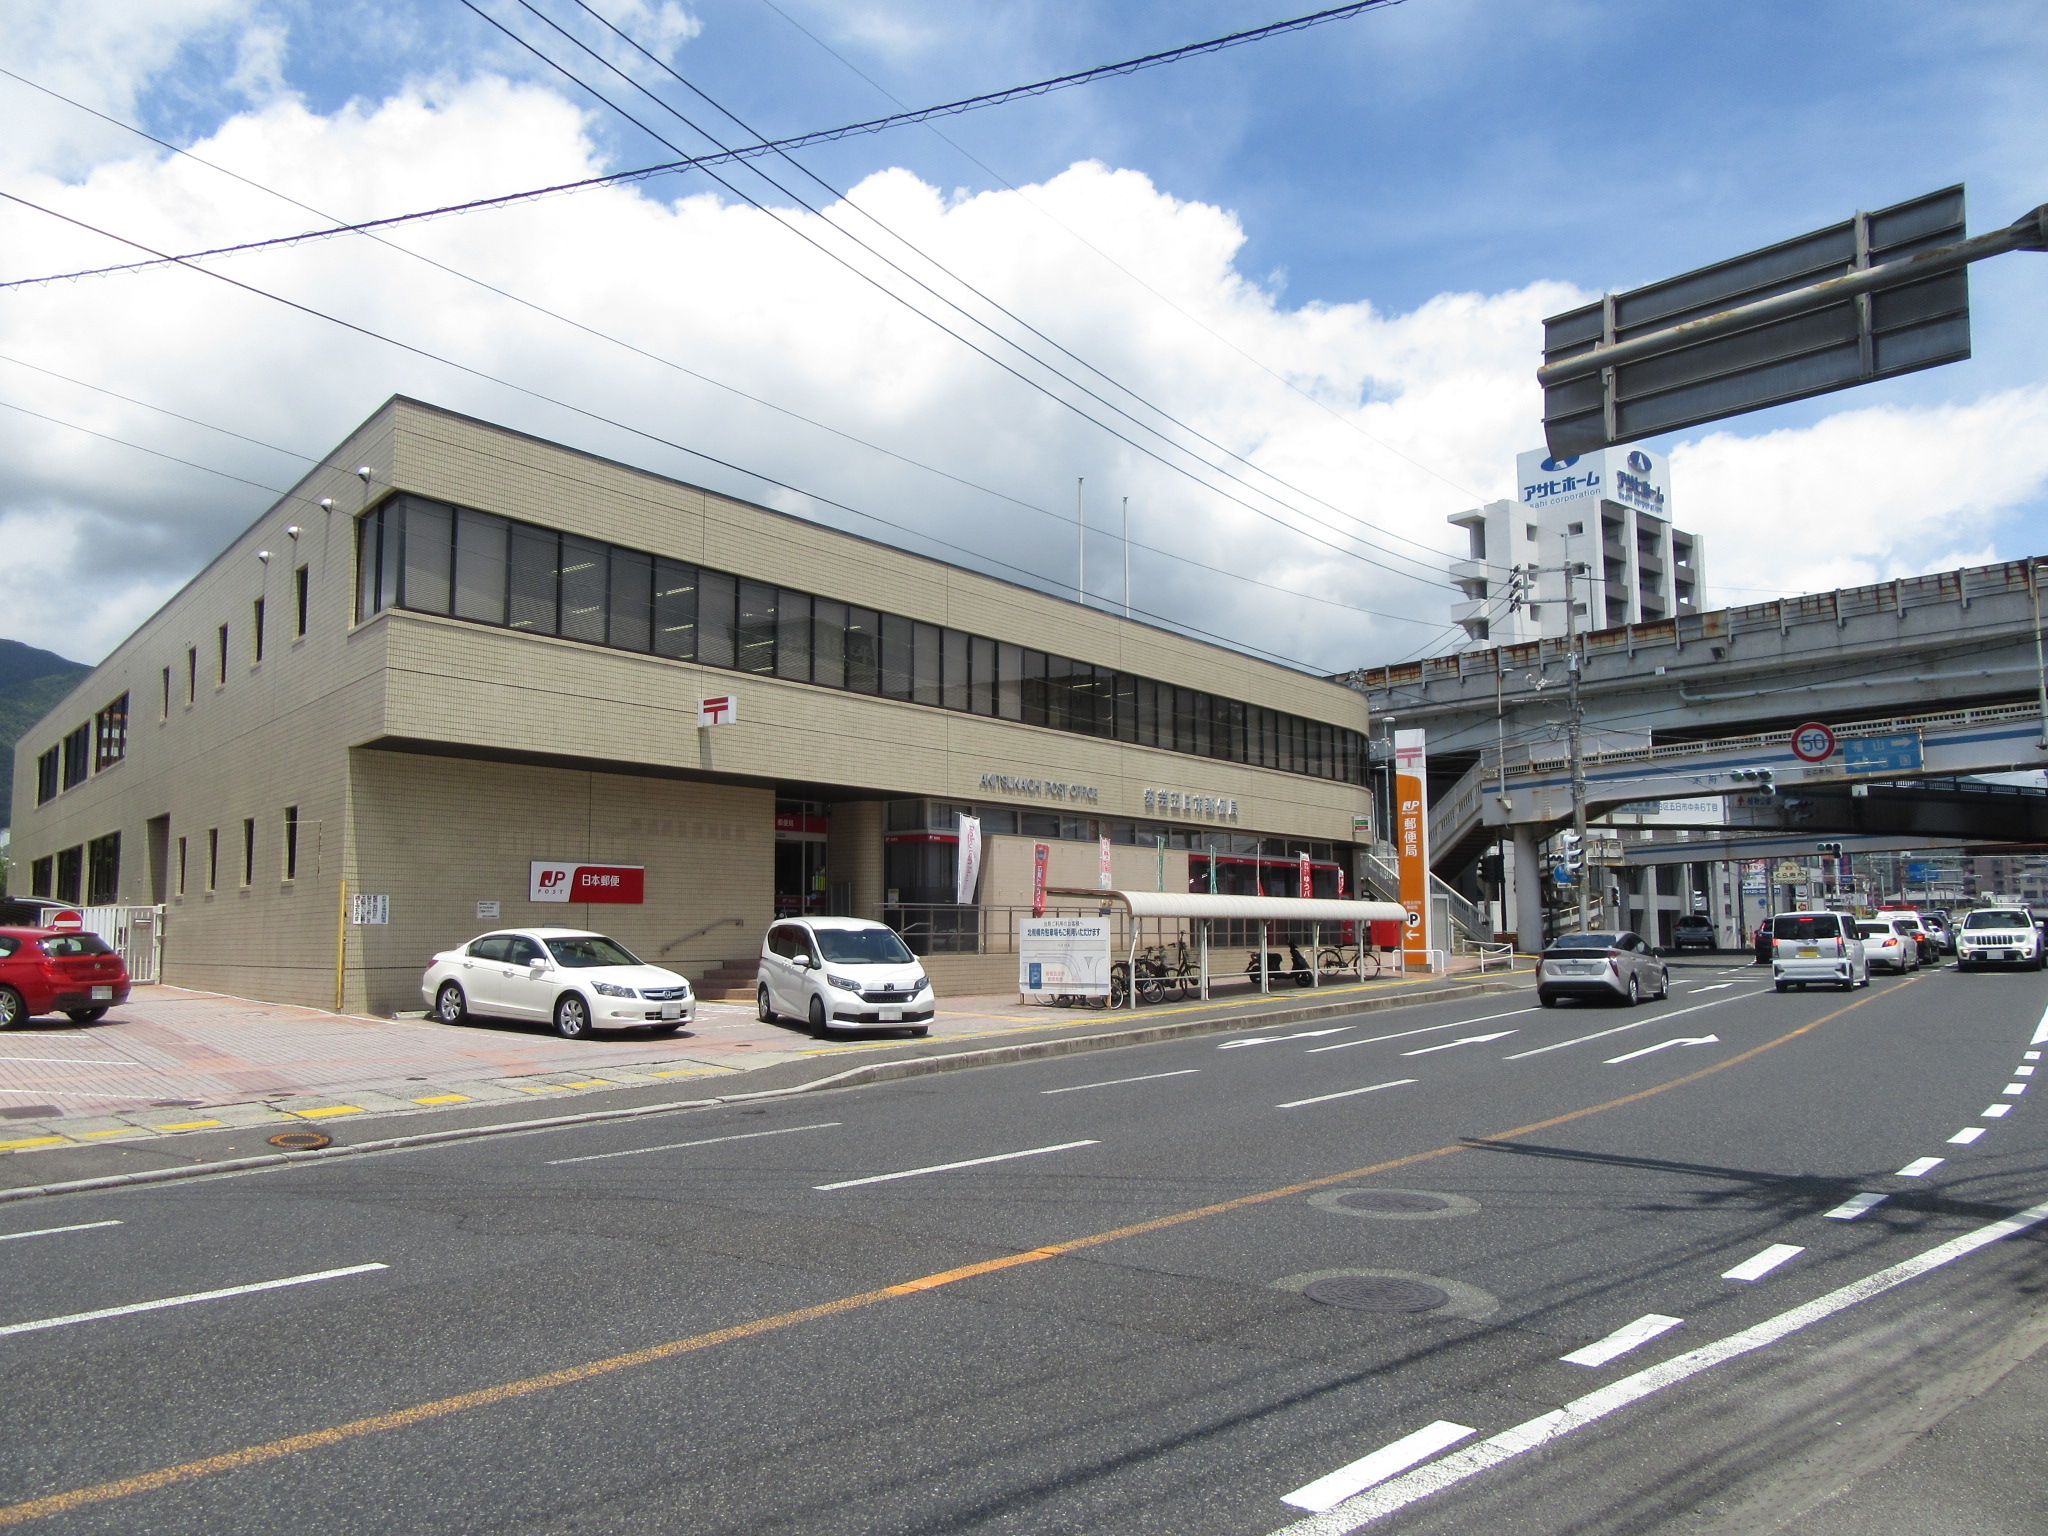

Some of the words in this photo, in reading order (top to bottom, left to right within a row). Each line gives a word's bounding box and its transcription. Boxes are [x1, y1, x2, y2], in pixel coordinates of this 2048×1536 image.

[1523, 471, 1600, 502] アサヒホーム
[1616, 470, 1664, 503] アサヒホーム
[1529, 501, 1548, 509] sahi
[1551, 488, 1600, 505] corporation
[1800, 733, 1826, 752] 50
[1805, 768, 1831, 776] ここから
[1045, 781, 1068, 796] POST
[1070, 784, 1098, 800] OFFICE
[1144, 788, 1238, 815] 安芸五日市郵便局
[1402, 801, 1420, 811] JP
[777, 818, 794, 827] 郵便局
[1404, 818, 1418, 857] 郵便局
[539, 870, 566, 887] JP
[582, 874, 620, 887] 日本郵便
[1410, 914, 1419, 925] P
